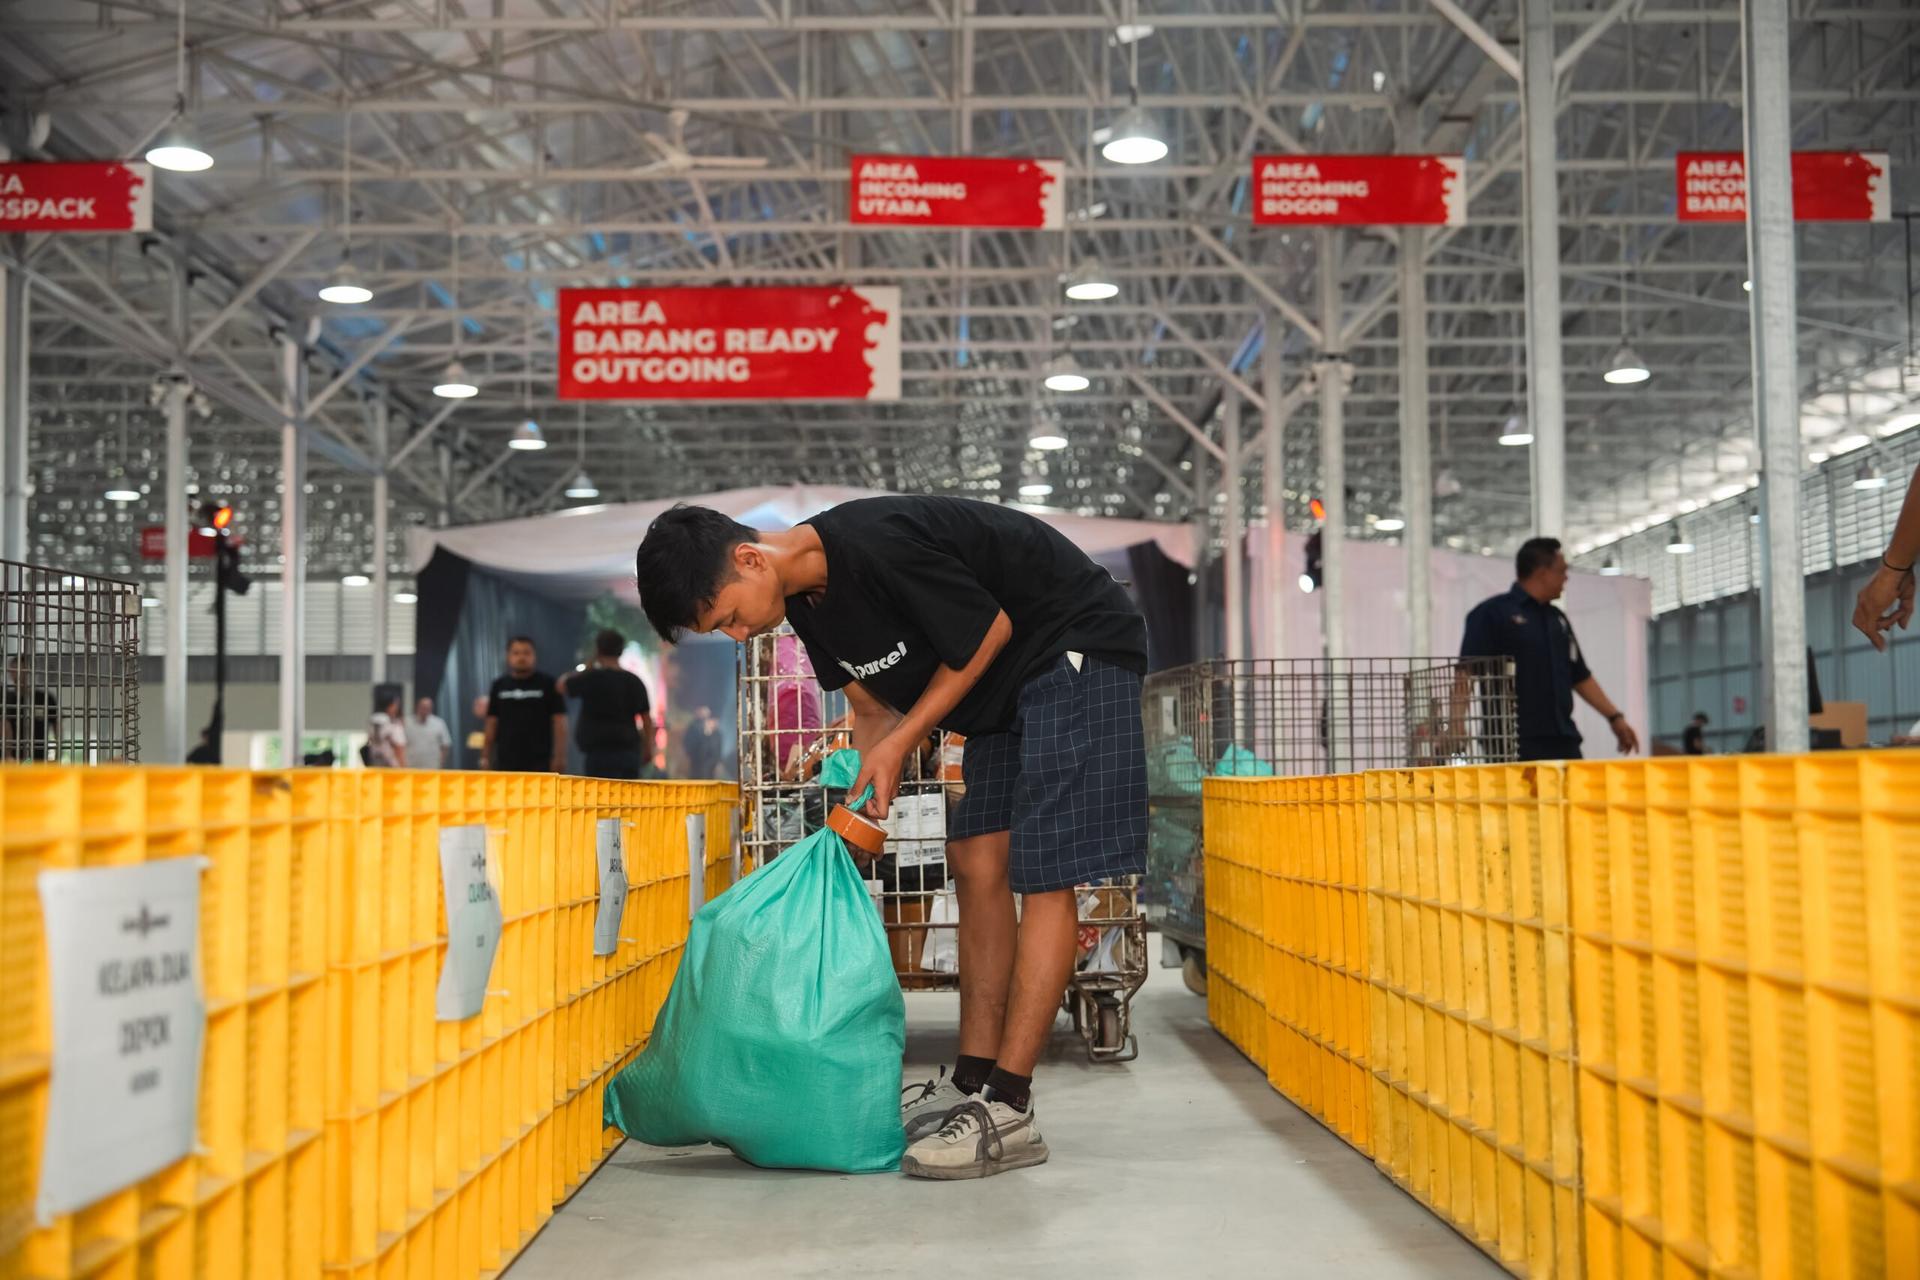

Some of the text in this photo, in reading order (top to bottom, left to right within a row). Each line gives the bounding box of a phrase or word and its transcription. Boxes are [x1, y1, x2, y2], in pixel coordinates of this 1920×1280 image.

[860, 162, 919, 179] AREA
[1262, 163, 1320, 178] AREA
[1686, 161, 1744, 176] AREA
[860, 181, 966, 200] INCOMING
[1262, 180, 1369, 197] INCOMING
[859, 199, 932, 216] UTARA
[1262, 199, 1339, 215] BOGOR
[572, 301, 666, 325] AREA
[573, 328, 838, 354] BARANG READY
[572, 357, 750, 383] OUTGOING
